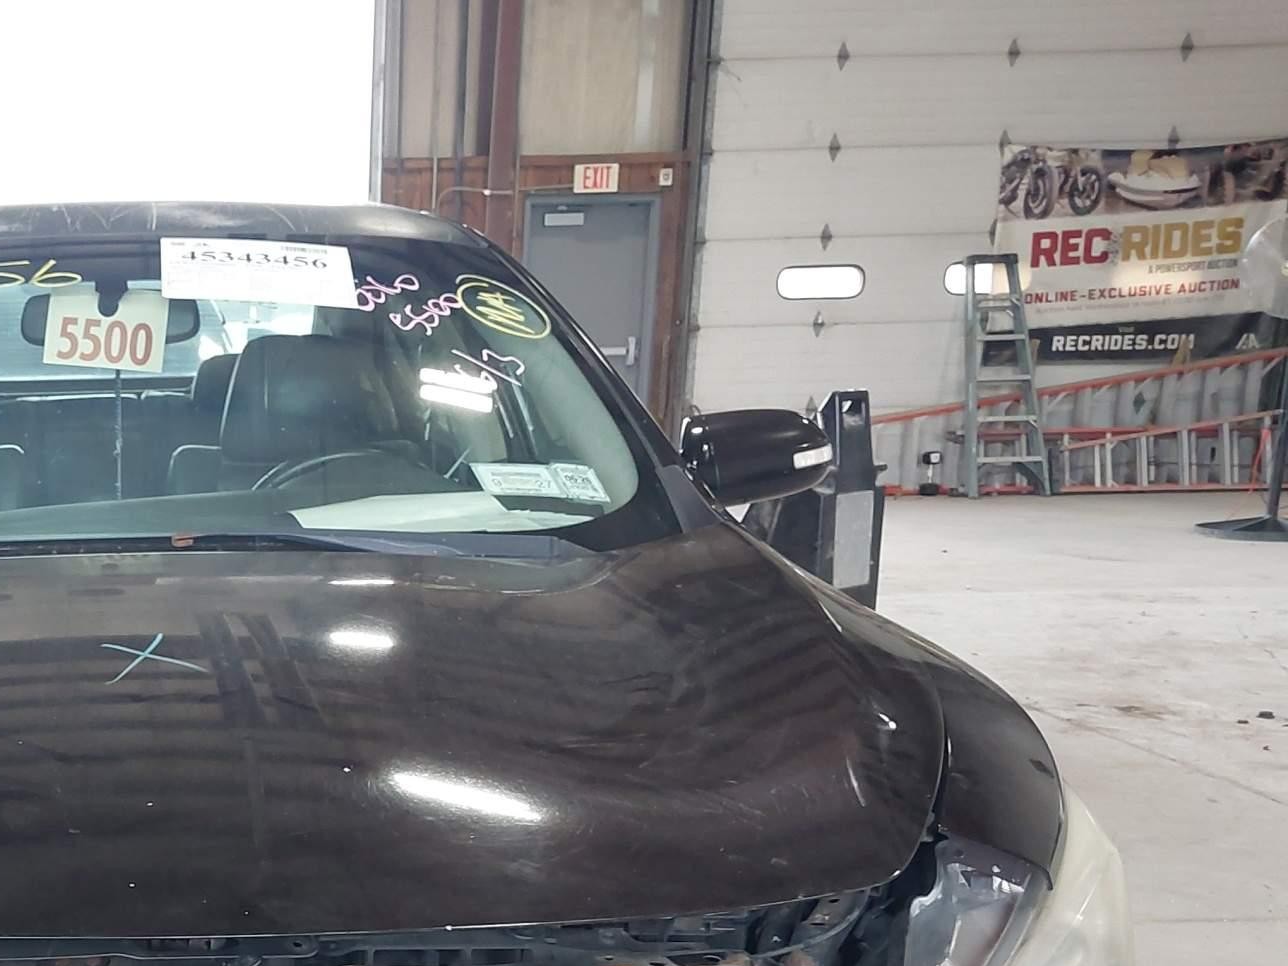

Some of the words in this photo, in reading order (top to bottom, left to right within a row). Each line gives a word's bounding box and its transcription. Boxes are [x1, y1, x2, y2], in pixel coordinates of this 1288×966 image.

[583, 166, 612, 189] EXIT
[1030, 227, 1112, 268] REC
[1122, 218, 1244, 261] RIDES
[181, 250, 328, 269] 45343456
[1024, 283, 1172, 303] ONLINE-EXCLUSIVE
[1177, 278, 1240, 294] AUCTION
[55, 314, 155, 367] 5500
